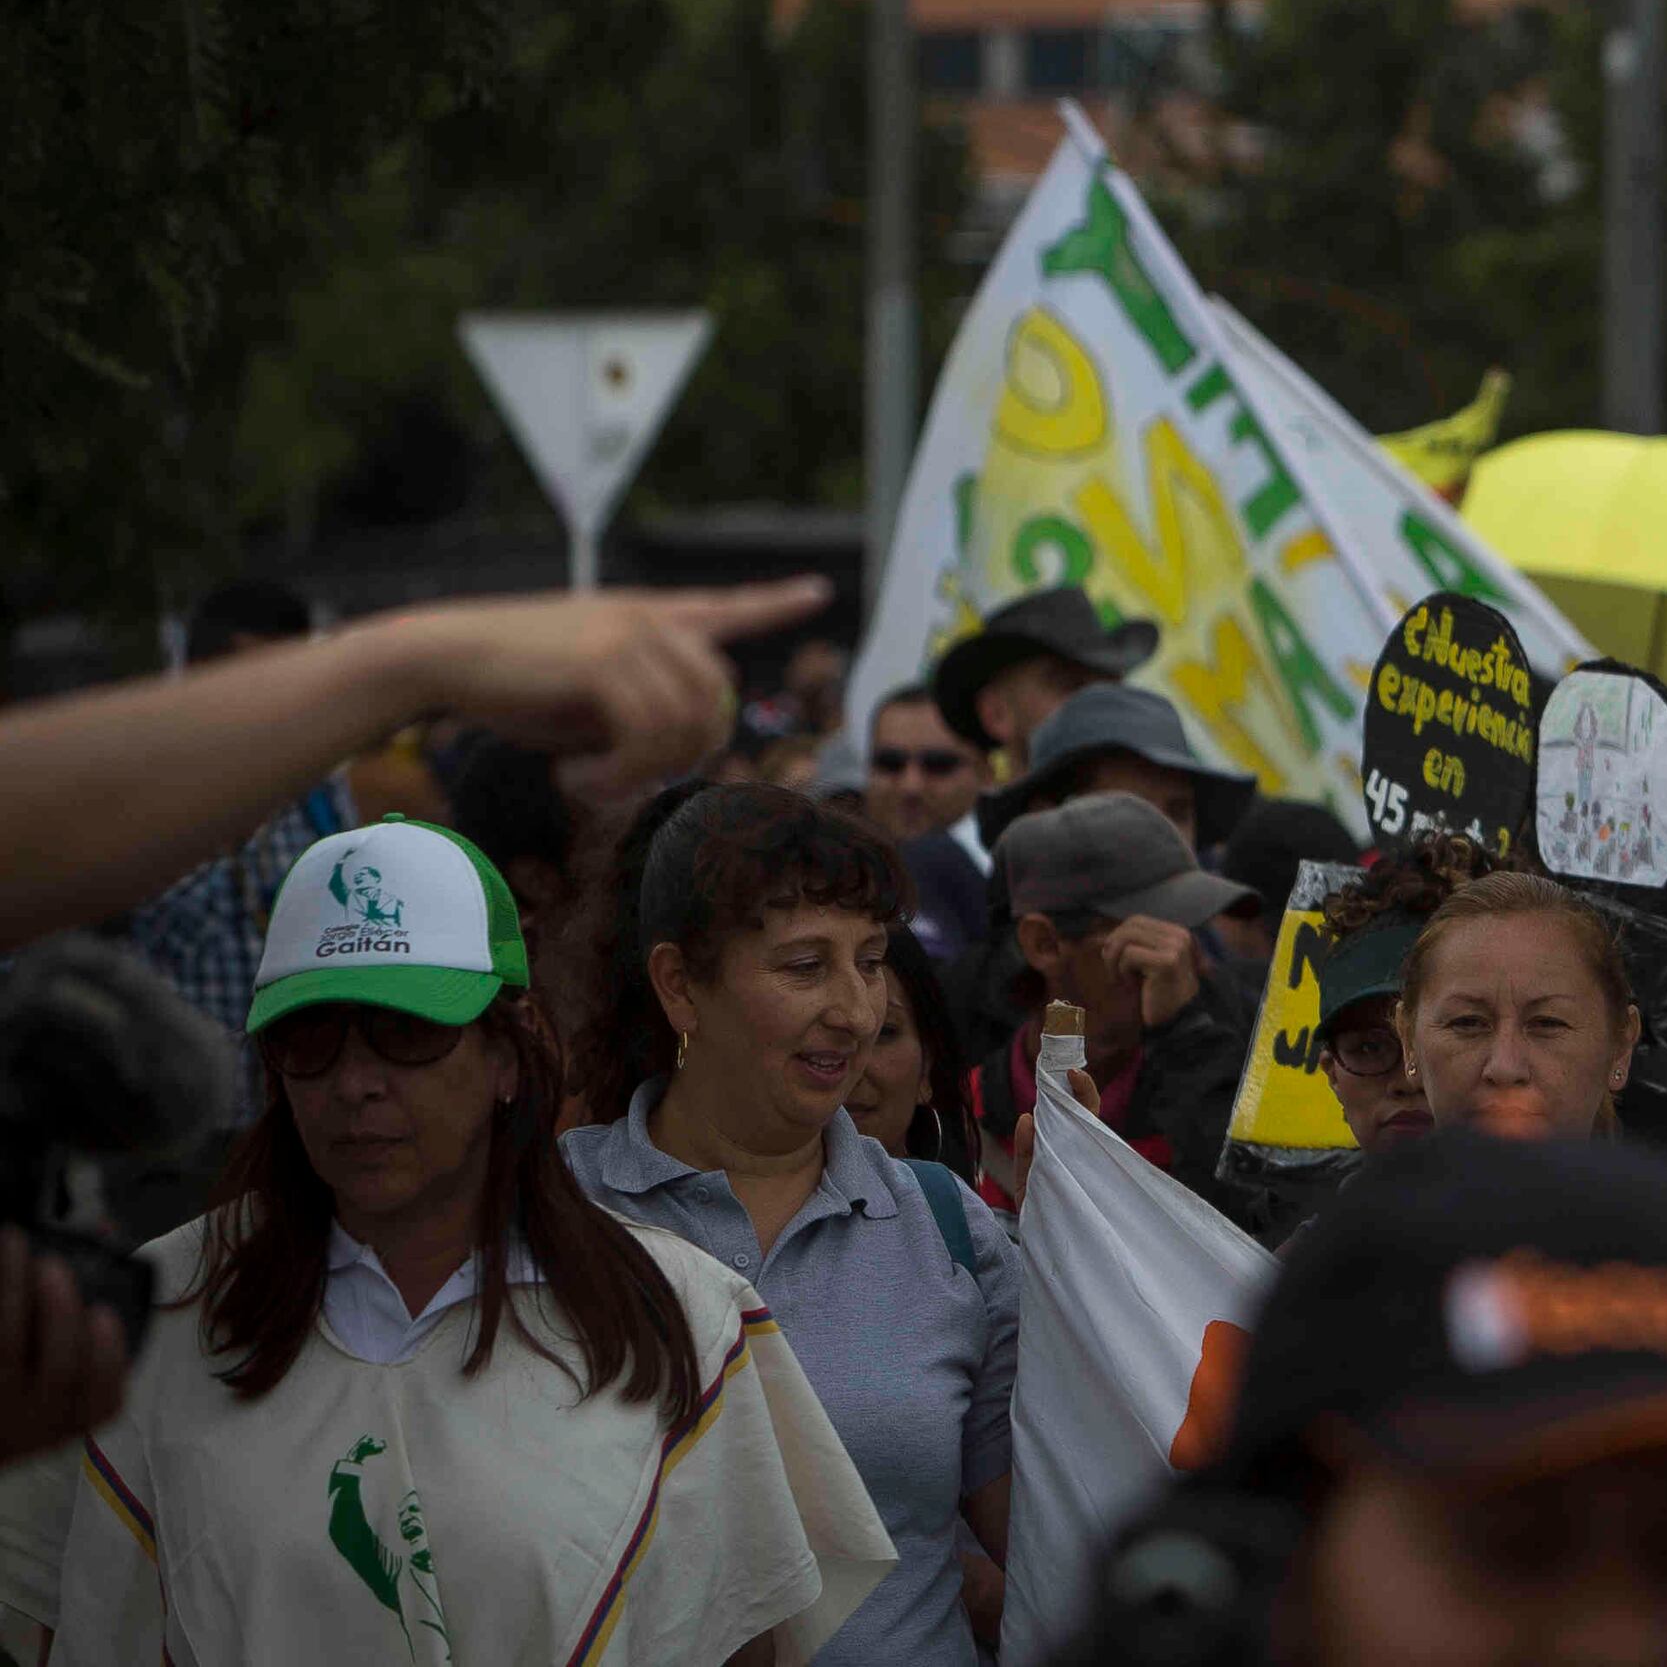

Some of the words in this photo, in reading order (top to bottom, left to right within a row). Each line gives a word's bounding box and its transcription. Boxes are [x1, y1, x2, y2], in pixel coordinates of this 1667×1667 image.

[1423, 747, 1465, 798] en
[1365, 768, 1409, 834] 45
[316, 934, 411, 958] Gaitán
